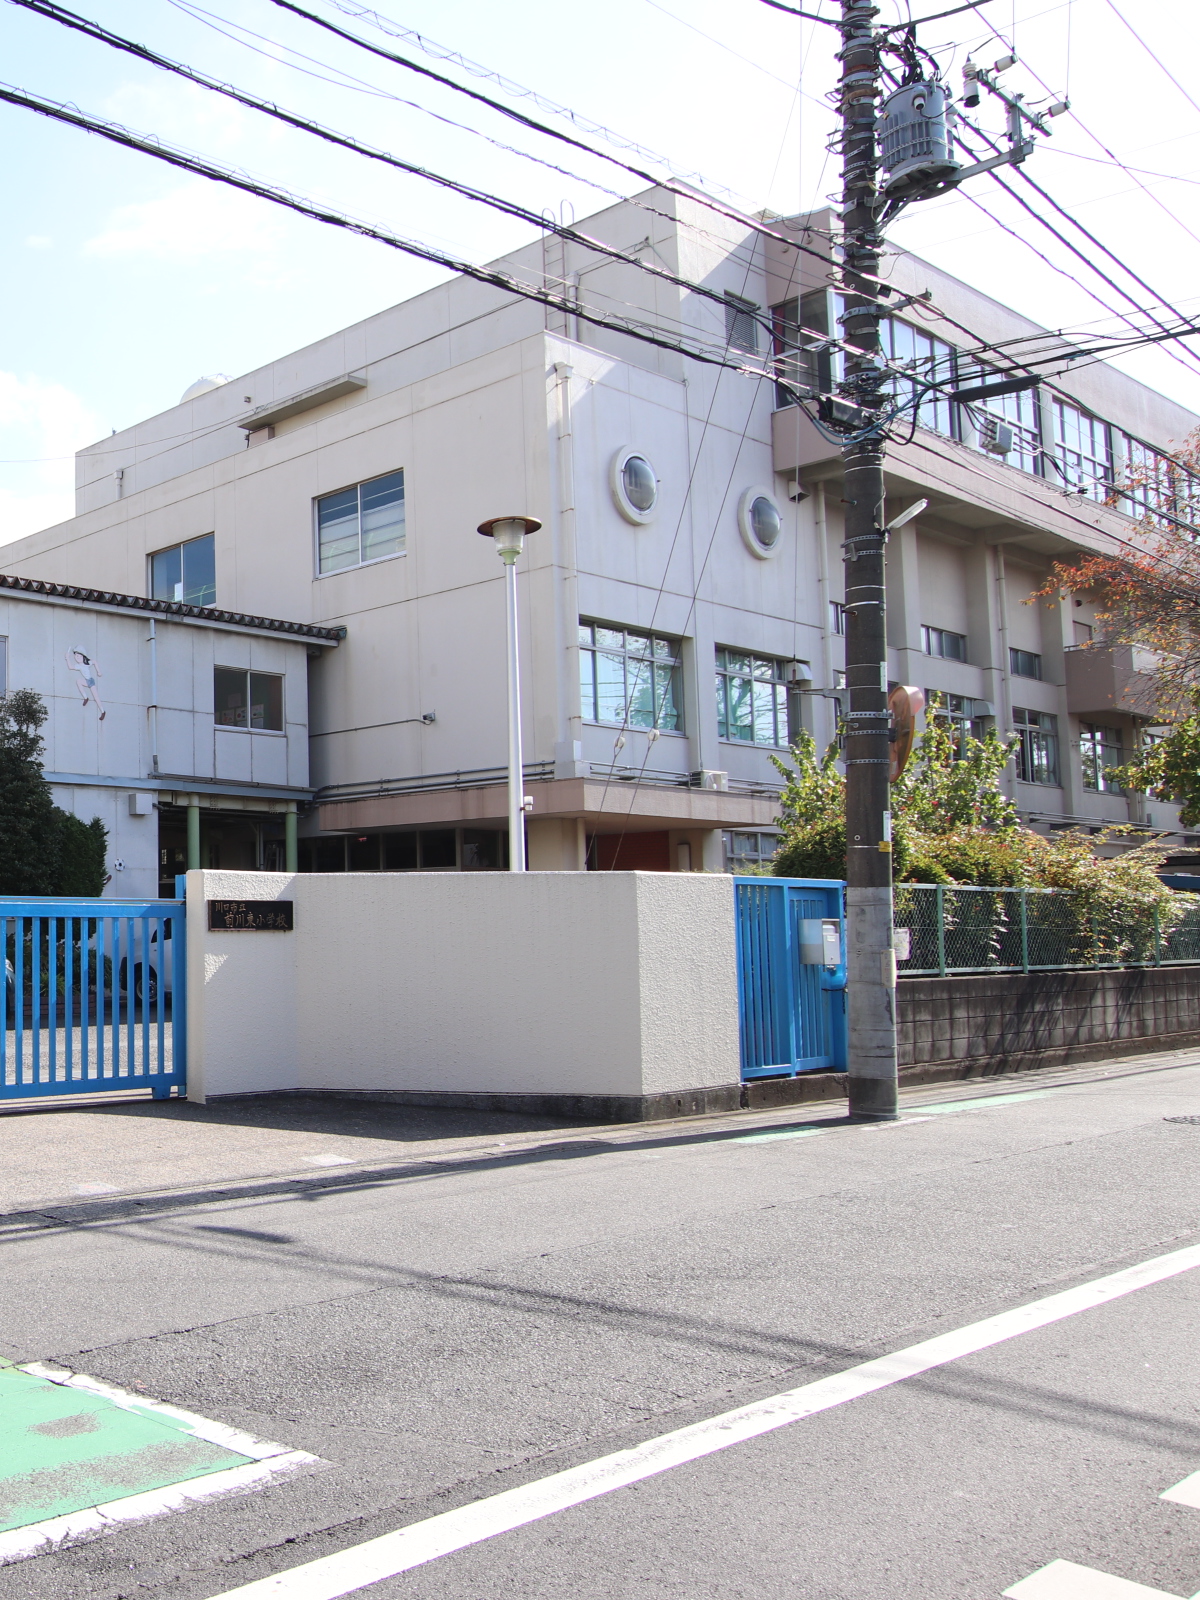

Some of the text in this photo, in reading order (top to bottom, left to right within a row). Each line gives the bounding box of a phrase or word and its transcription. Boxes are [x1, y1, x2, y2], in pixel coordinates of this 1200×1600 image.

[215, 902, 247, 914] 川口市立
[224, 911, 288, 928] 前川東小学校
